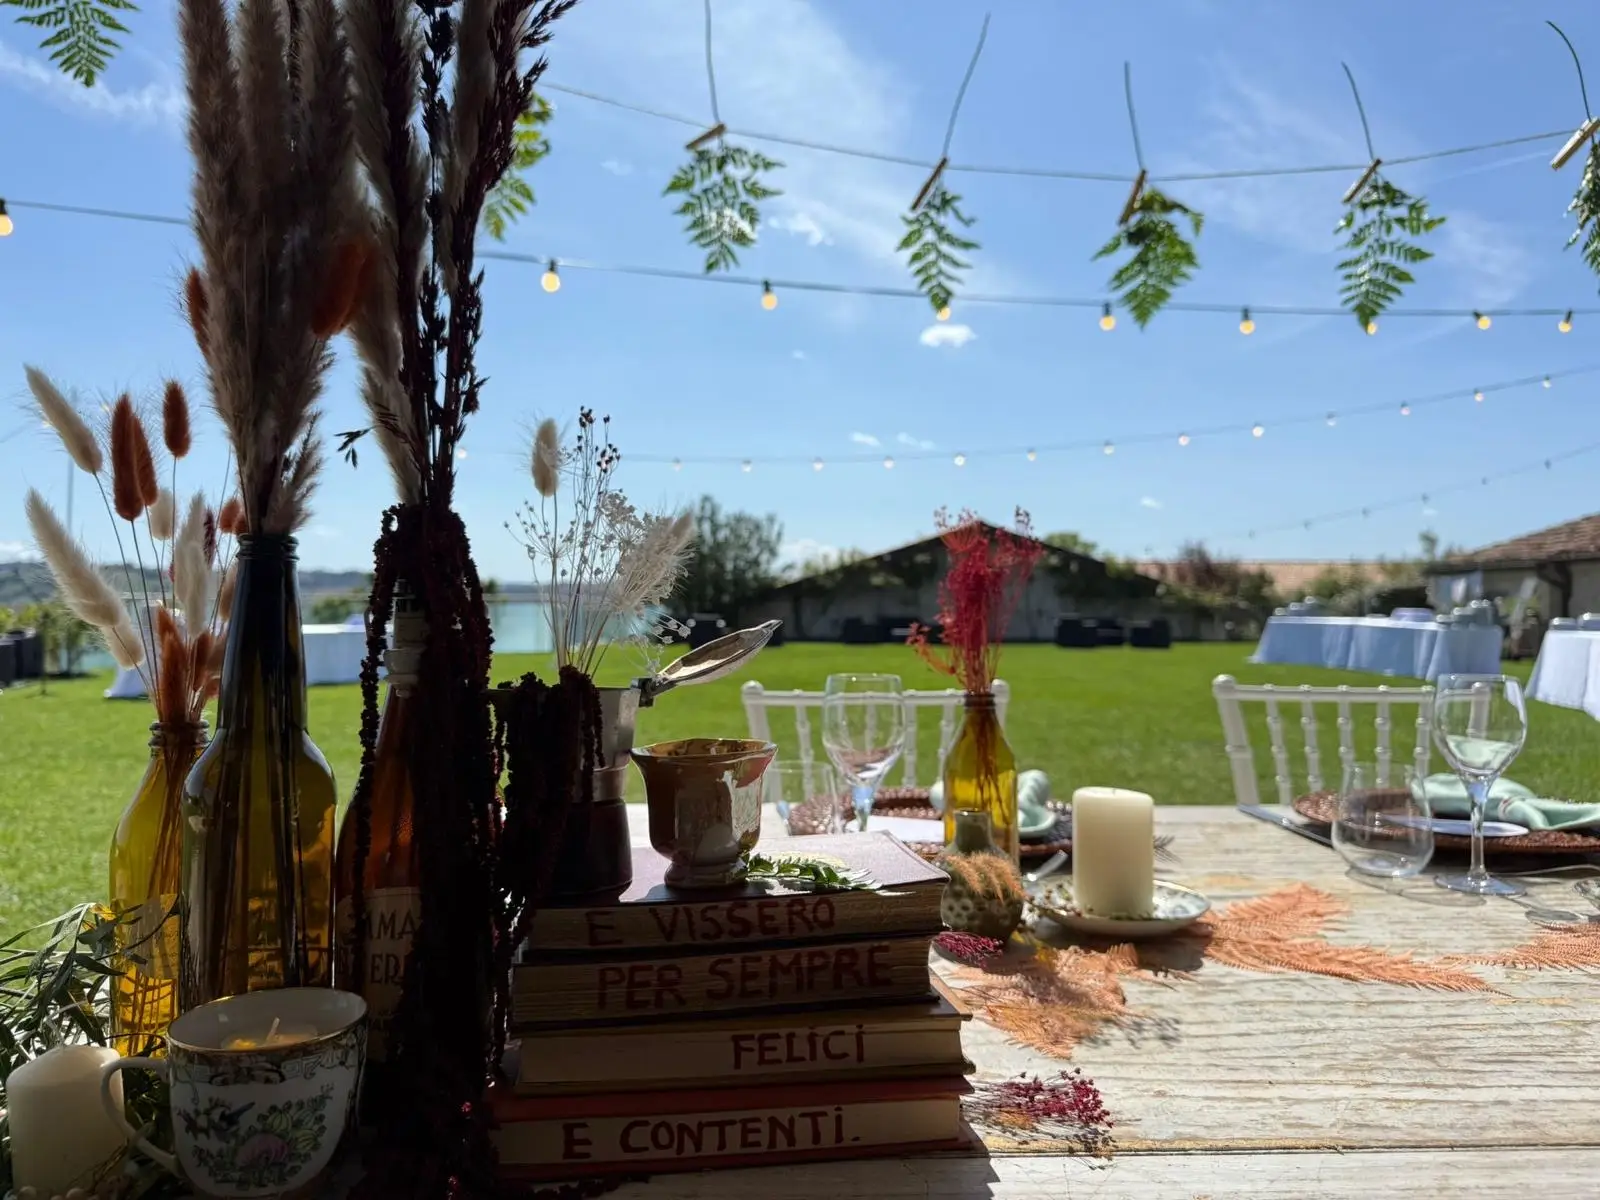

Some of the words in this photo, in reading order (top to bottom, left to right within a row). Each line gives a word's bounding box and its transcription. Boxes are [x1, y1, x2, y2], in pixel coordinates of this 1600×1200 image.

[586, 910, 621, 946] E
[648, 898, 836, 942] VISSERO
[597, 964, 686, 1009] PER
[705, 945, 894, 1000] SEMPRE
[562, 1122, 593, 1160] E
